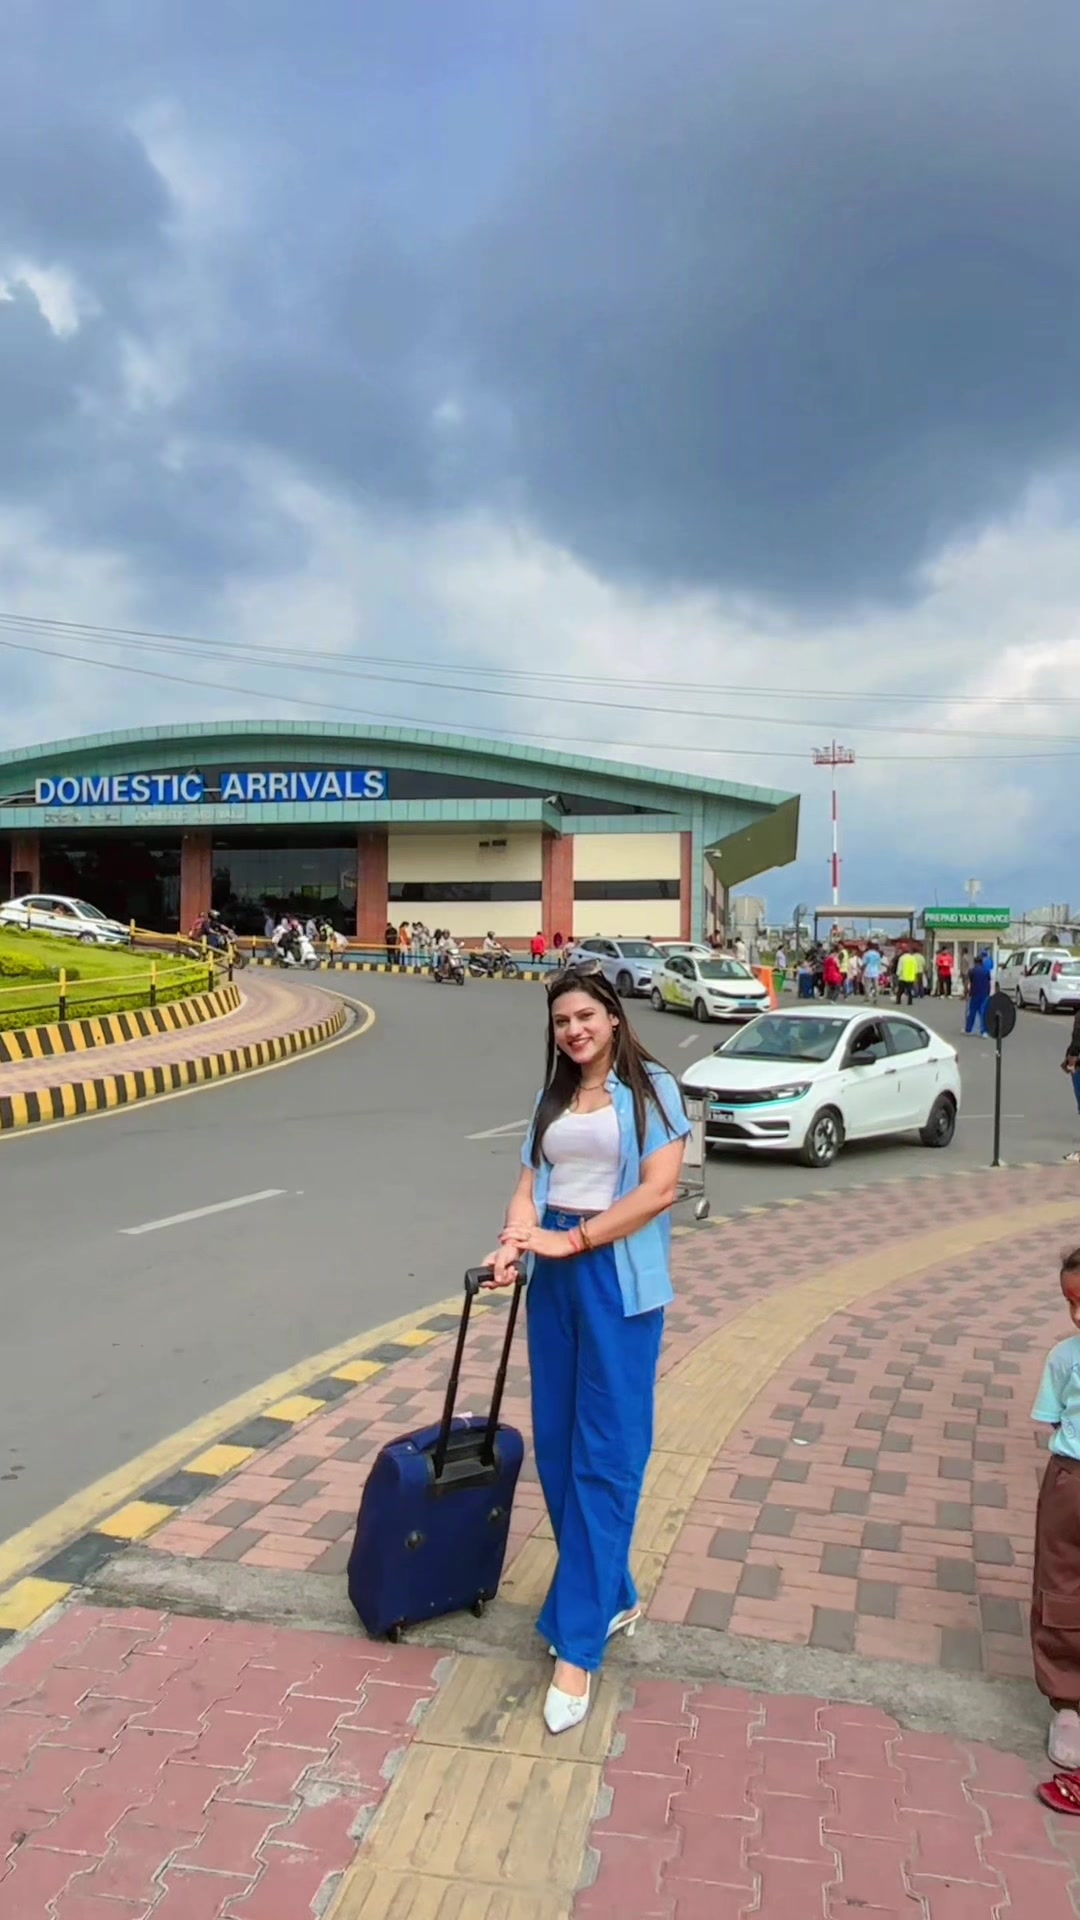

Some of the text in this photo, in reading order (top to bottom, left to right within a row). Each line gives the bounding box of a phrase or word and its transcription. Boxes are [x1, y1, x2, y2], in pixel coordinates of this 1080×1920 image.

[35, 770, 385, 804] DOMESTIC ARRIVALS
[925, 913, 1009, 924] PREPAID TAXI SERVICE
